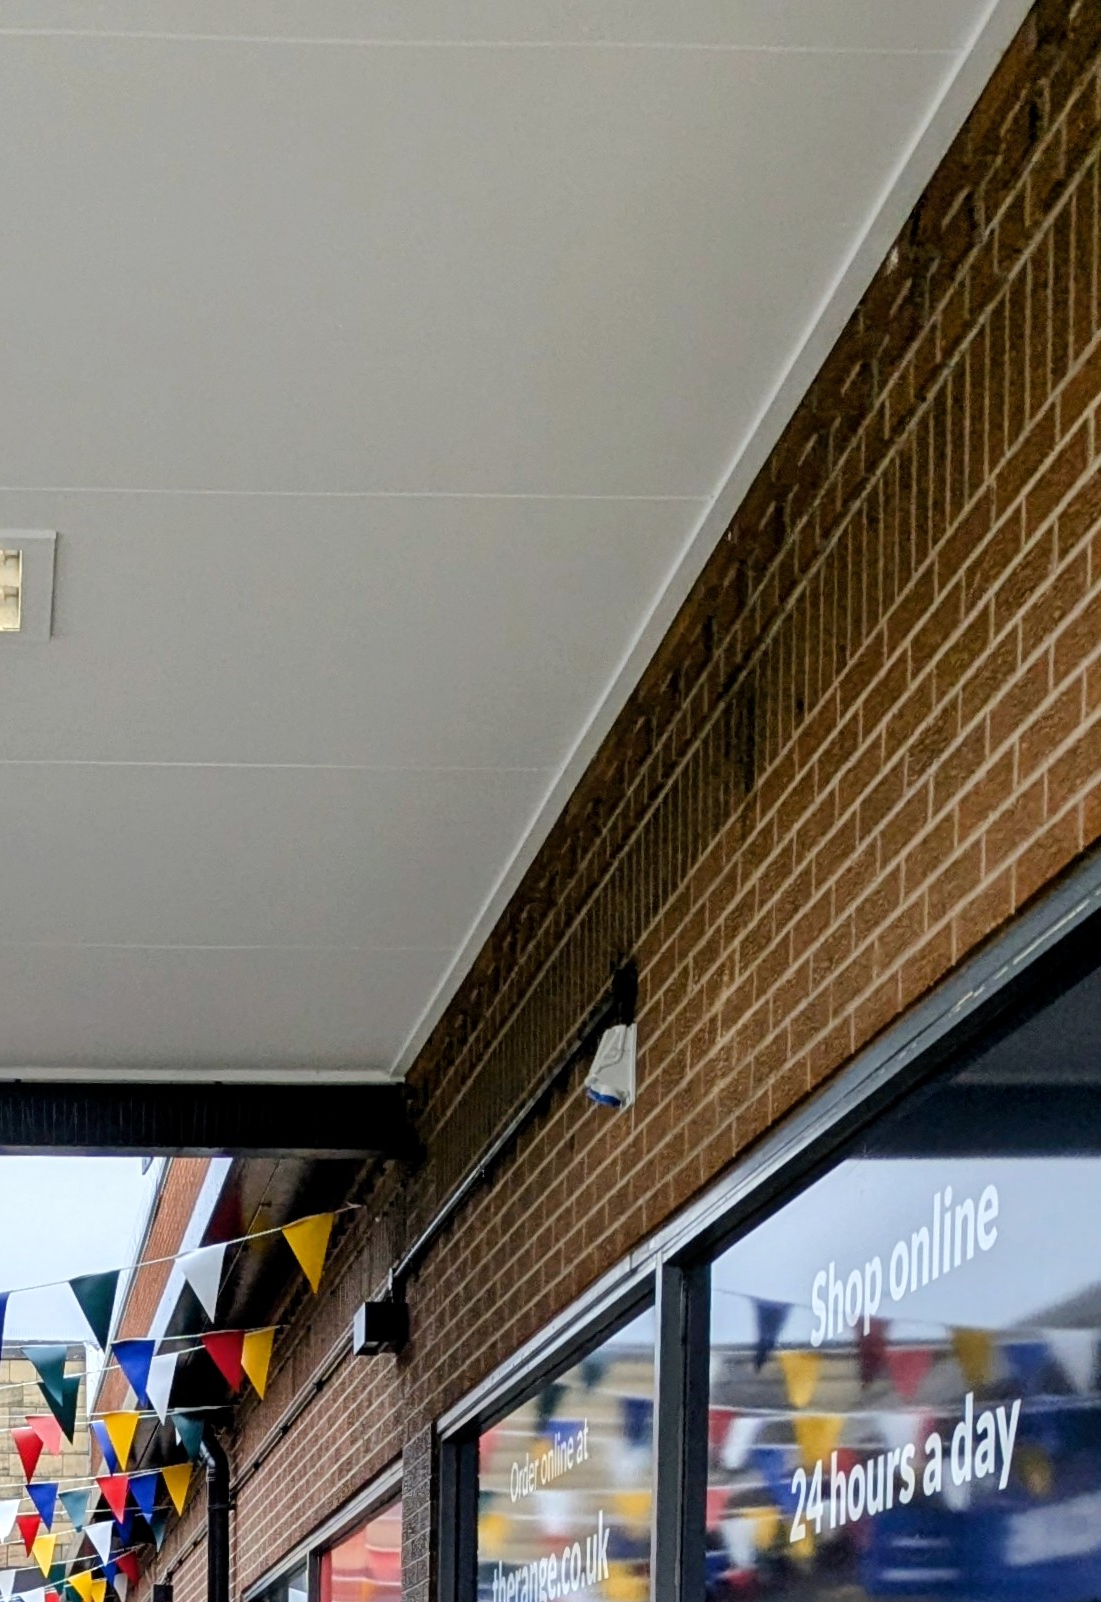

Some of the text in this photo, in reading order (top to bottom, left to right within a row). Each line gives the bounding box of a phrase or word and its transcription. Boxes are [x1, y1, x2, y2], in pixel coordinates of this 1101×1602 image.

[810, 1184, 999, 1348] Shop online
[509, 1417, 590, 1503] Order online at
[789, 1392, 1022, 1543] 24 hours a day
